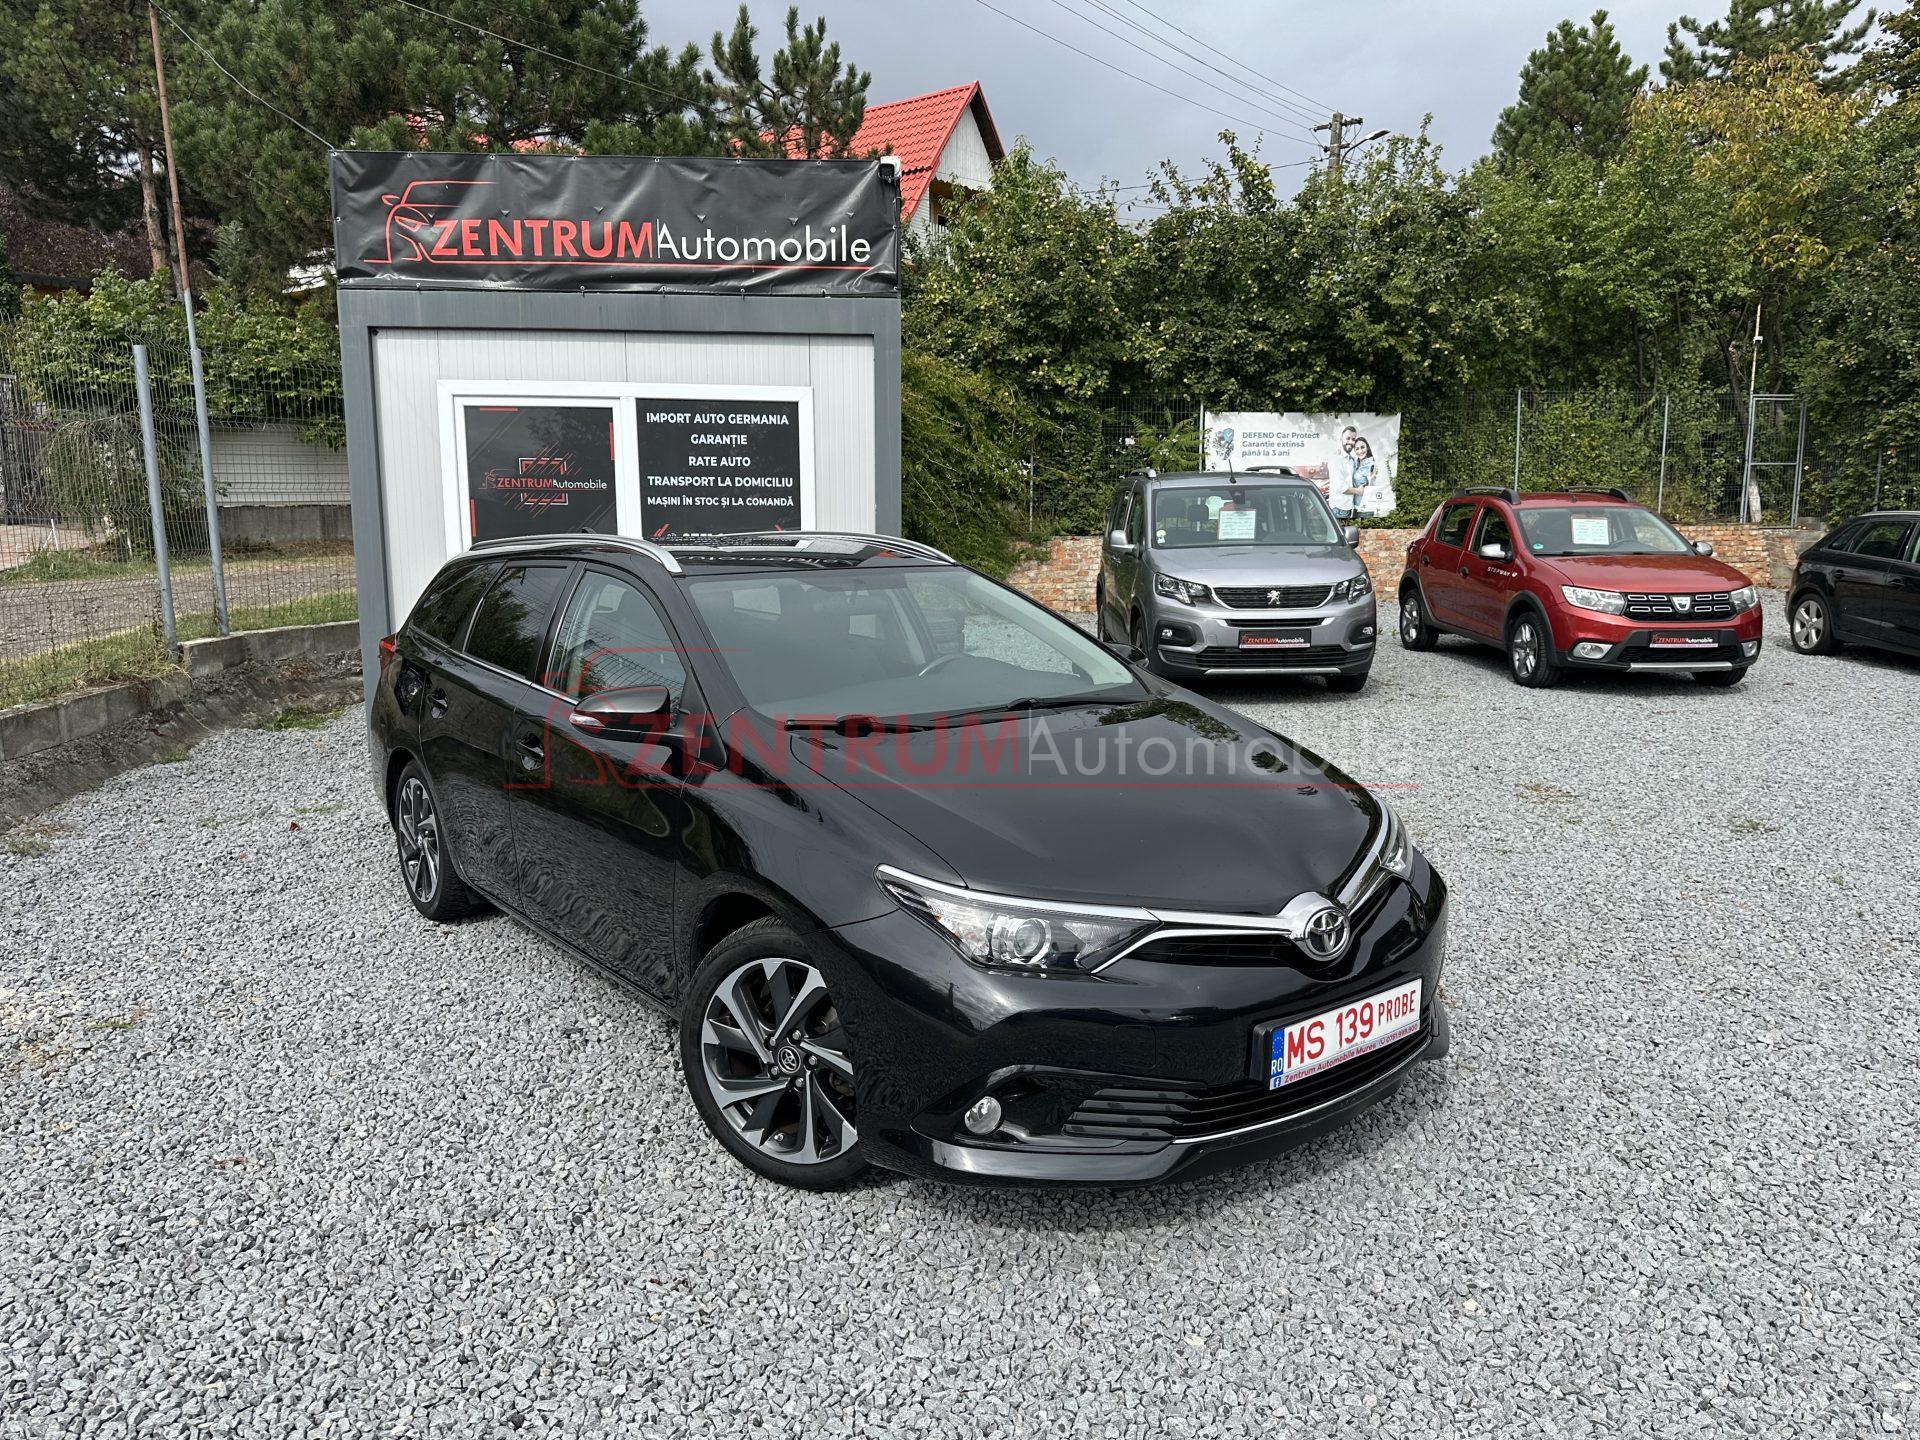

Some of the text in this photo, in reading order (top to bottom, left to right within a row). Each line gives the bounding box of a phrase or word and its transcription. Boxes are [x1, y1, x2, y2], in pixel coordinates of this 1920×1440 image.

[430, 218, 872, 263] ZENTRUM Automobile
[646, 412, 790, 425] IMPORT AUTO GERMANIA
[690, 433, 748, 448] GARANȚIE
[1242, 431, 1275, 439] DEFEND
[1276, 440, 1305, 448] extinsă
[1262, 448, 1270, 457] la
[1271, 449, 1277, 457] 3
[1277, 448, 1290, 457] ani
[688, 456, 751, 467] RATE AUTO
[496, 477, 608, 489] ZENTRUM Automobile
[647, 476, 793, 488] TRANSPORT LA DOMICILIU
[647, 494, 794, 508] MAȘINI ÎN STOC ȘI LA COMANDĂ
[1287, 989, 1417, 1069] MS 139 PROBE
[1270, 1057, 1283, 1076] RO
[1284, 1066, 1316, 1084] Zentrum
[1316, 1050, 1356, 1071] Automobile
